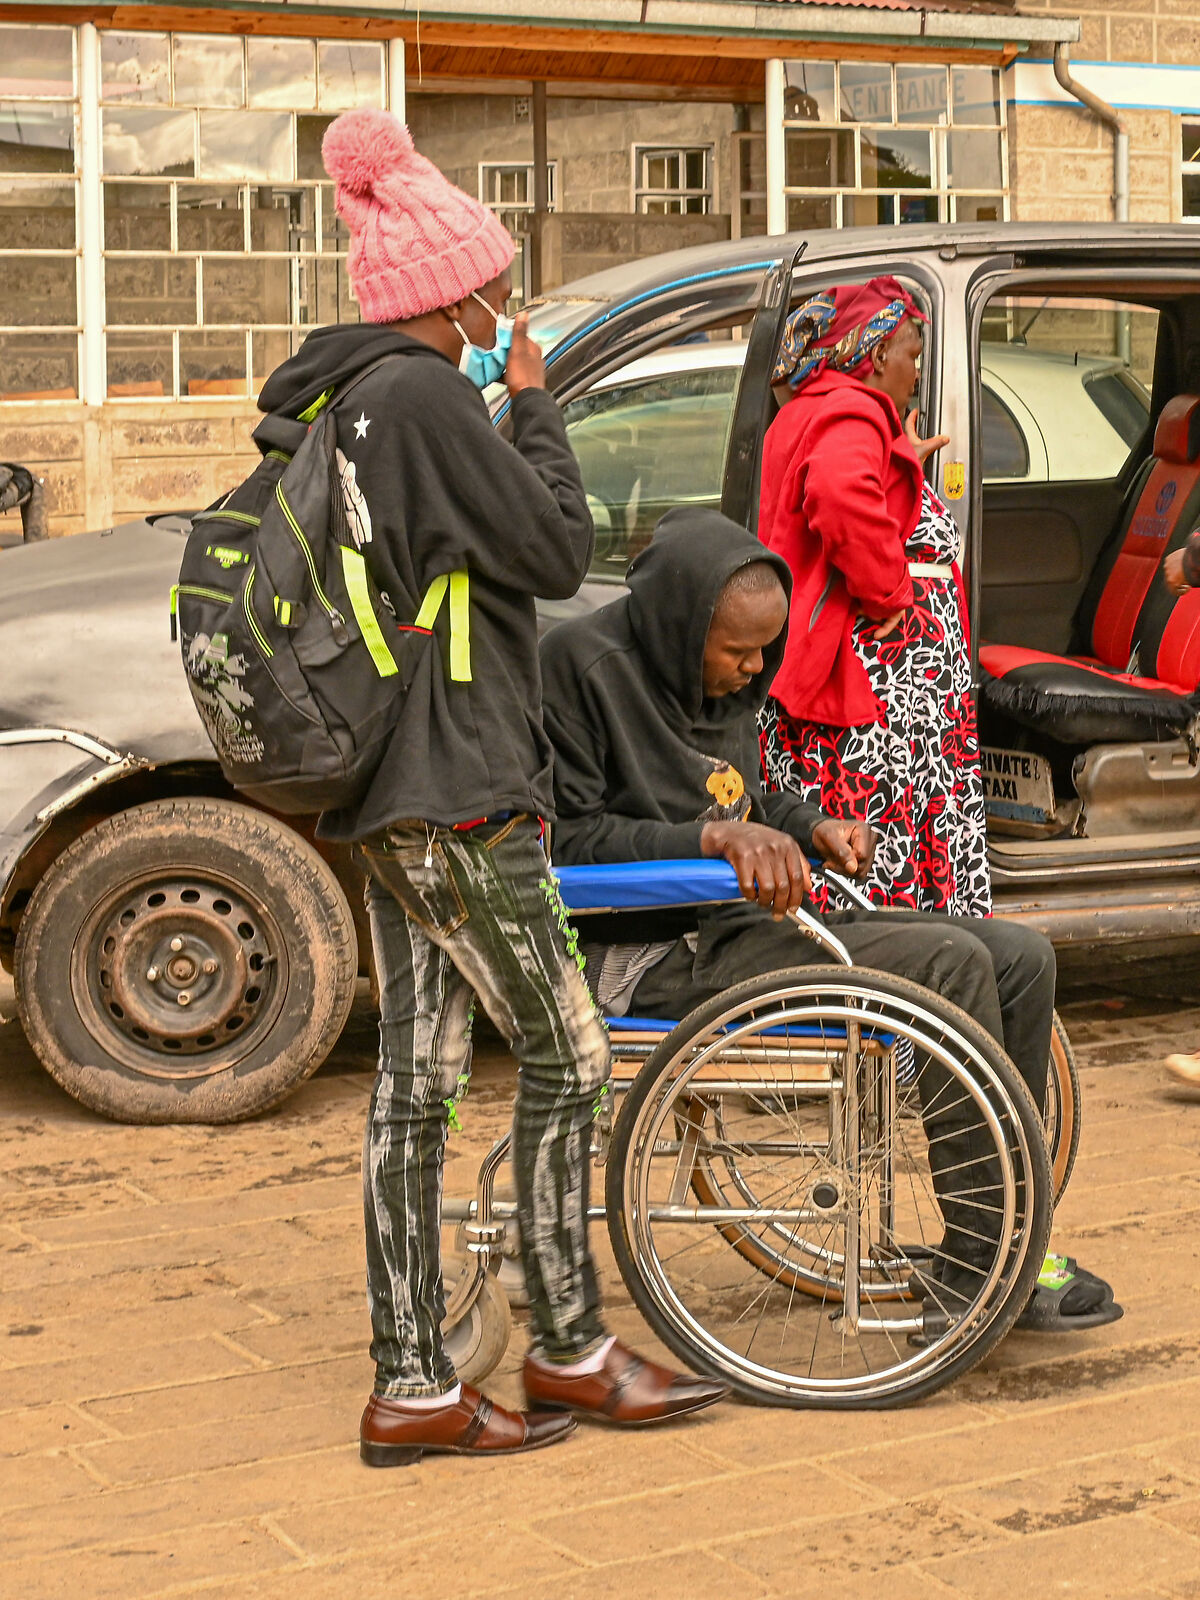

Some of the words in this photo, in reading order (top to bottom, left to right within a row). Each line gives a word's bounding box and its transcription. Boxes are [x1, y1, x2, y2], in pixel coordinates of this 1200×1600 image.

[852, 73, 966, 116] ENTRANCE
[980, 752, 1032, 779] RIVATE
[981, 777, 1019, 801] TAXI
